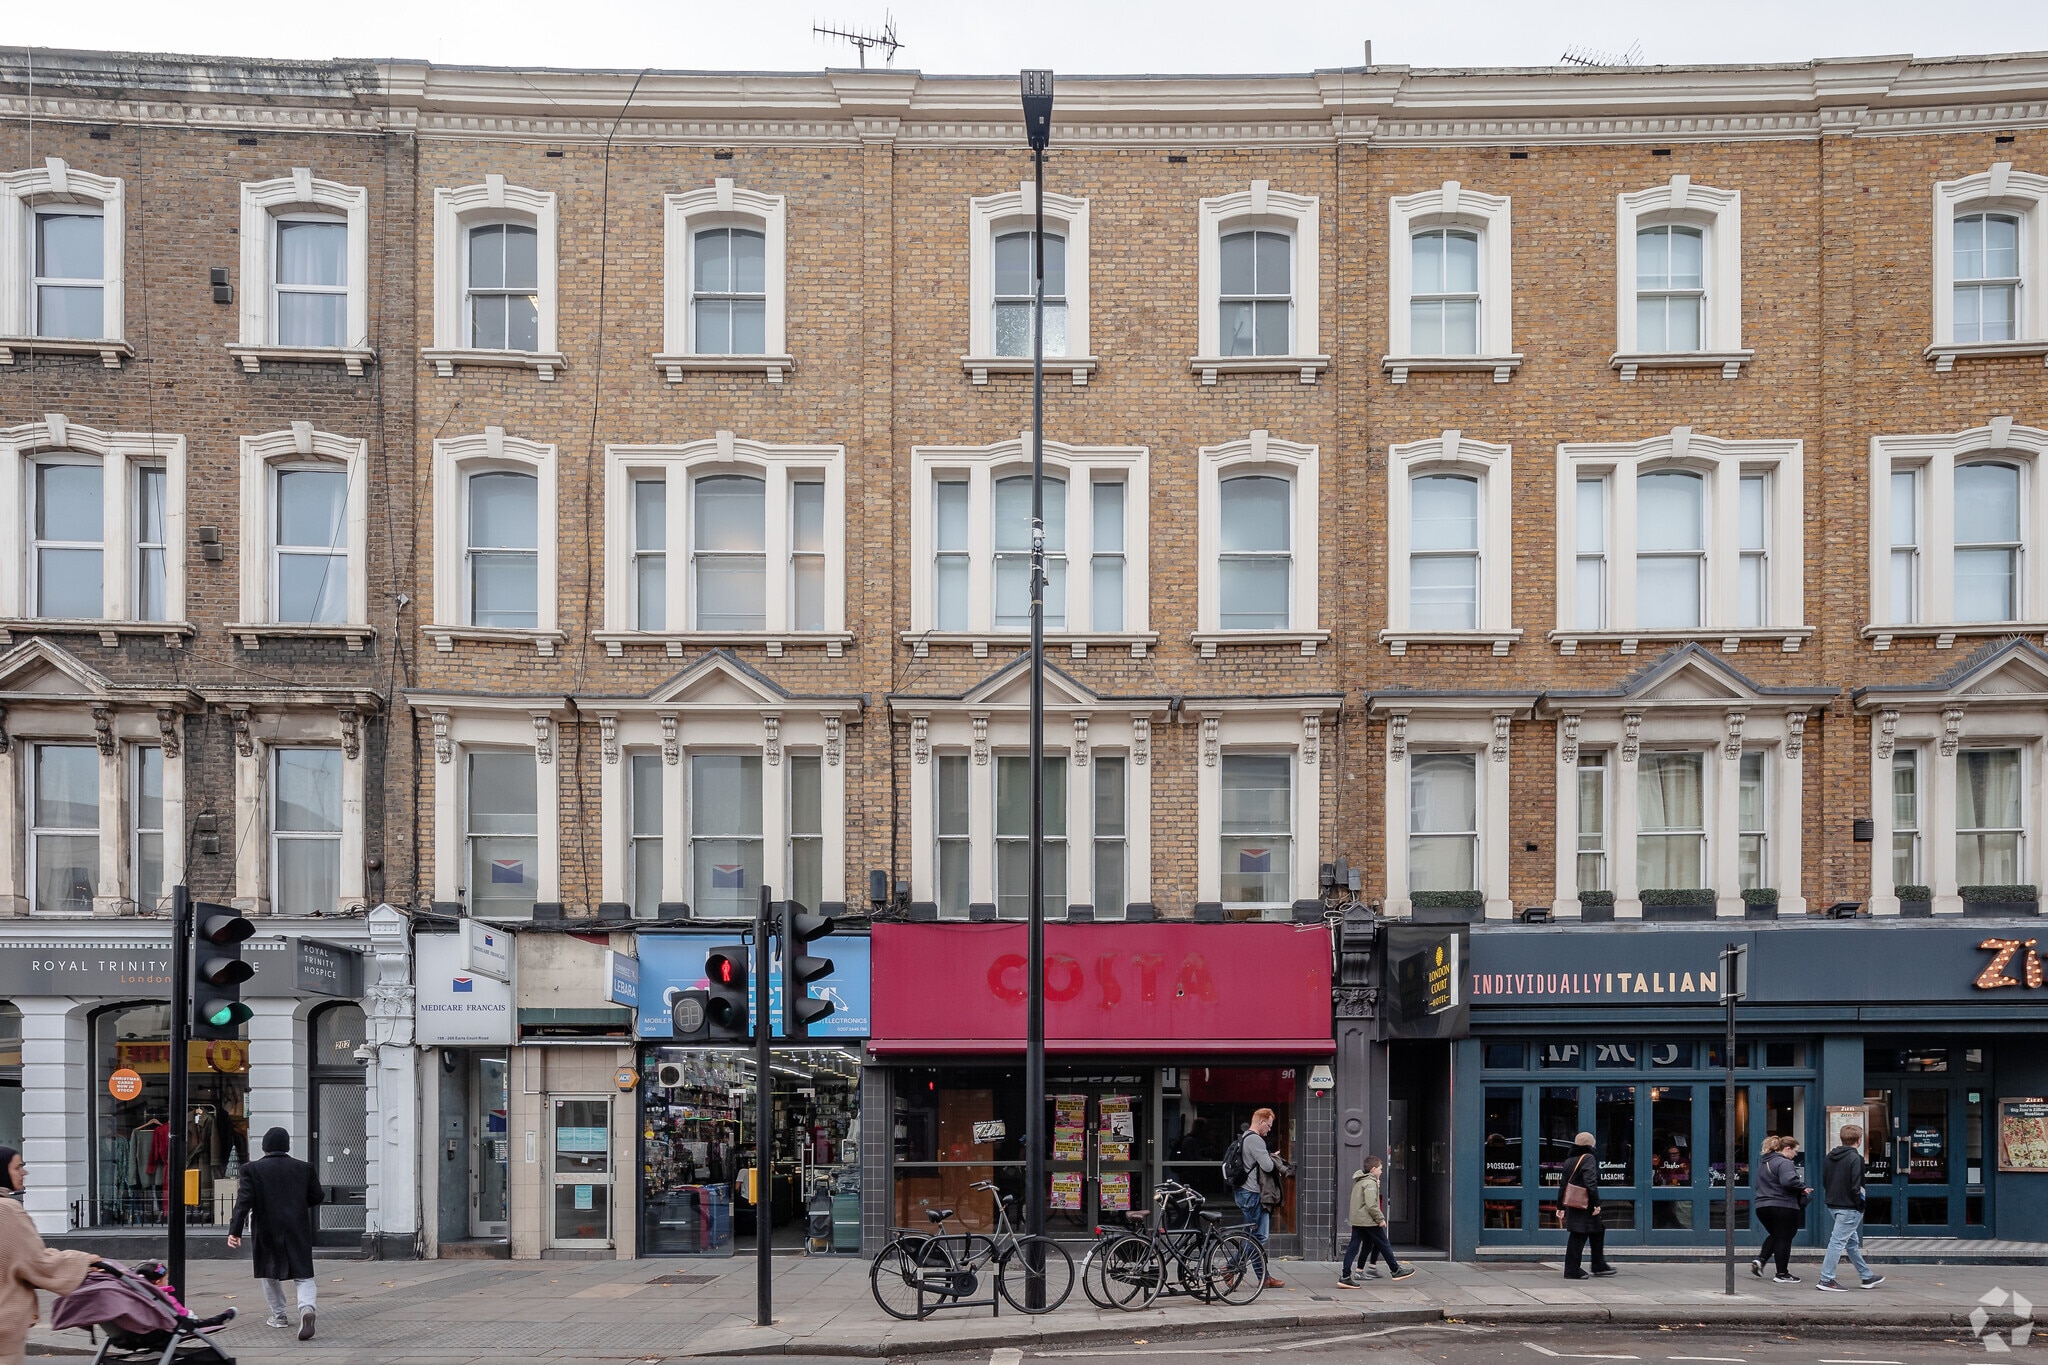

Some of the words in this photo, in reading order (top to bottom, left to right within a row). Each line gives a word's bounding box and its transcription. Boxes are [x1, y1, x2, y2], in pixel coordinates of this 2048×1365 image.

[304, 945, 329, 957] ROYAL
[32, 961, 88, 971] ROYAL
[98, 961, 168, 971] TRINITY
[304, 955, 334, 968] TRINITY
[304, 966, 336, 978] HOSPICE
[1428, 963, 1450, 982] LONDON
[121, 975, 171, 983] London
[987, 953, 1218, 1010] COSTA
[614, 978, 636, 998] LEBARA
[1431, 978, 1448, 994] COURT
[1432, 994, 1447, 1007] HOTEL
